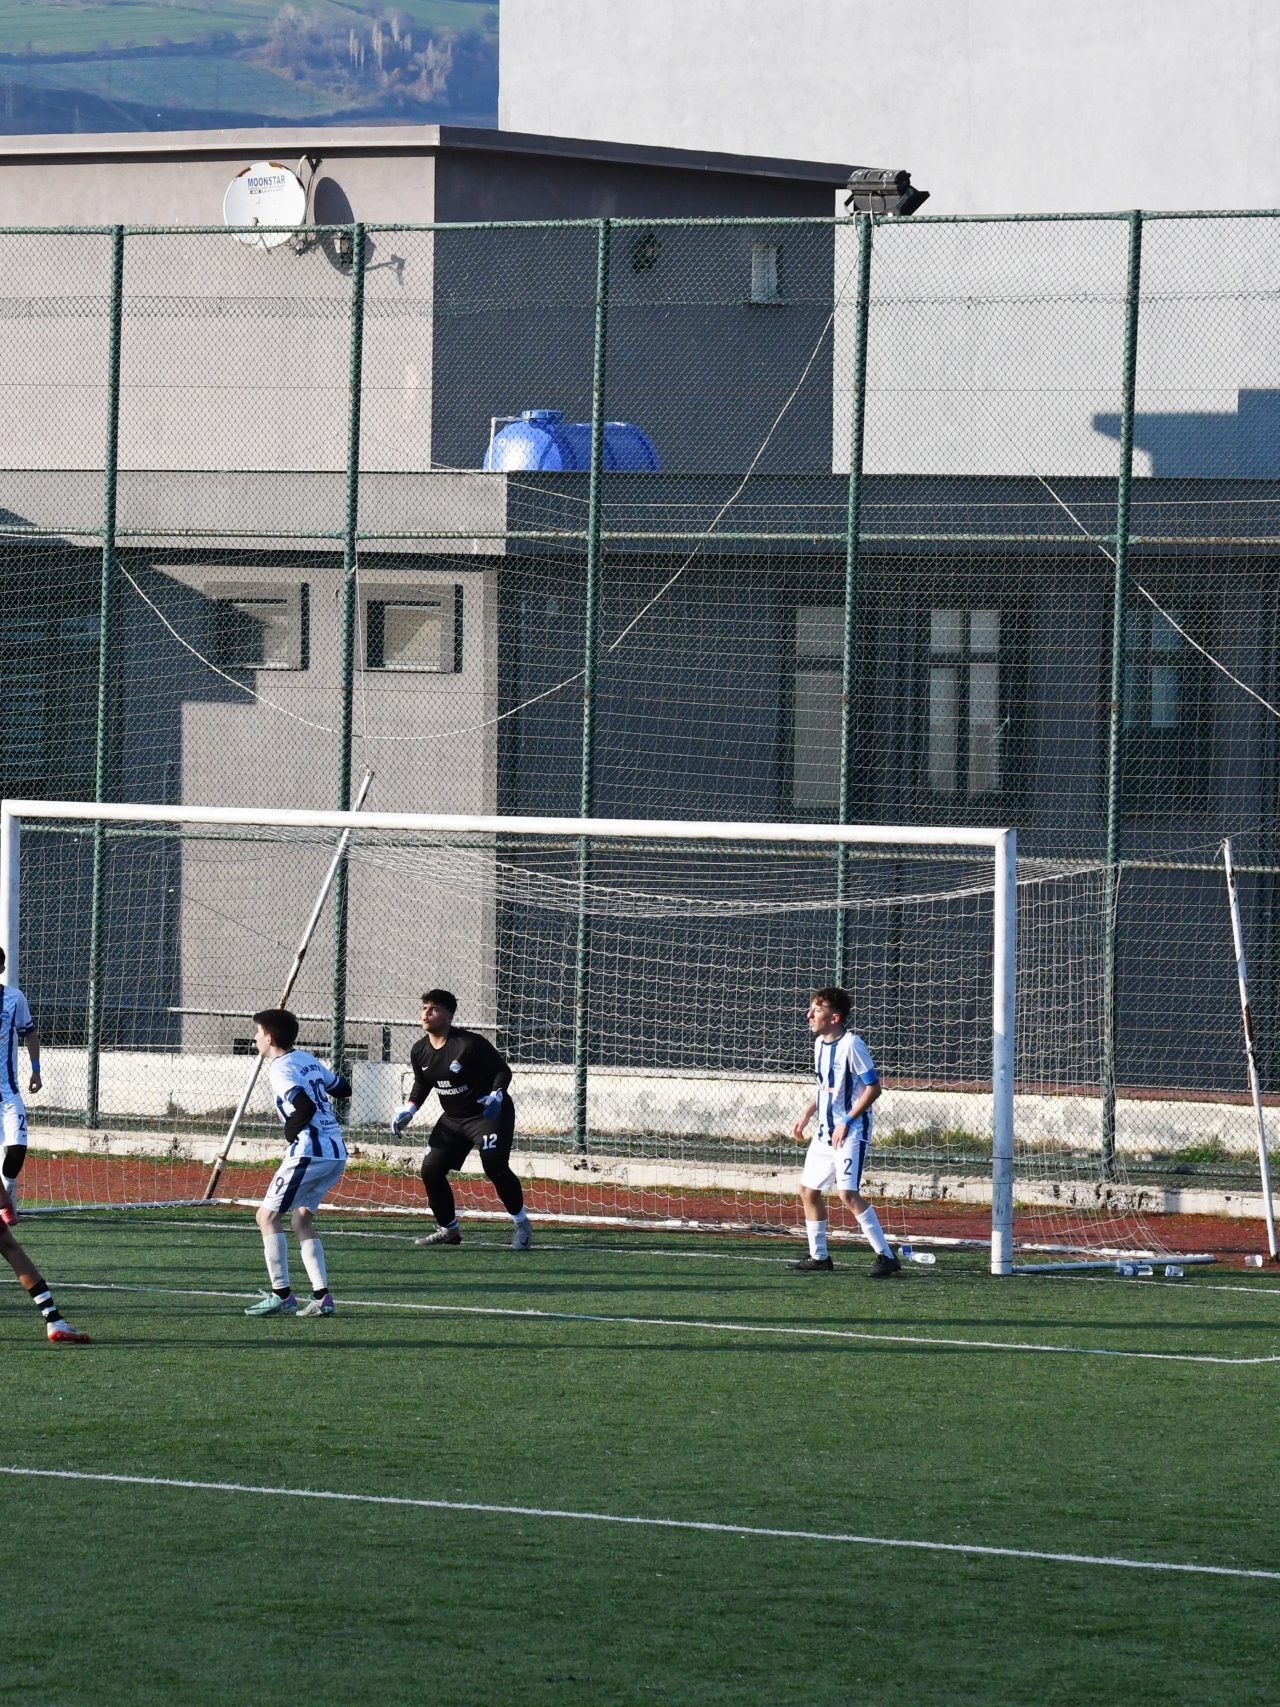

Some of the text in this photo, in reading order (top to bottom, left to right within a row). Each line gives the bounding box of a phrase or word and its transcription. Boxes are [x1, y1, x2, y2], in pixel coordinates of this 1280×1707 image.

[248, 175, 285, 187] MOONSTAR
[482, 1133, 498, 1150] 12
[844, 1158, 852, 1175] 2
